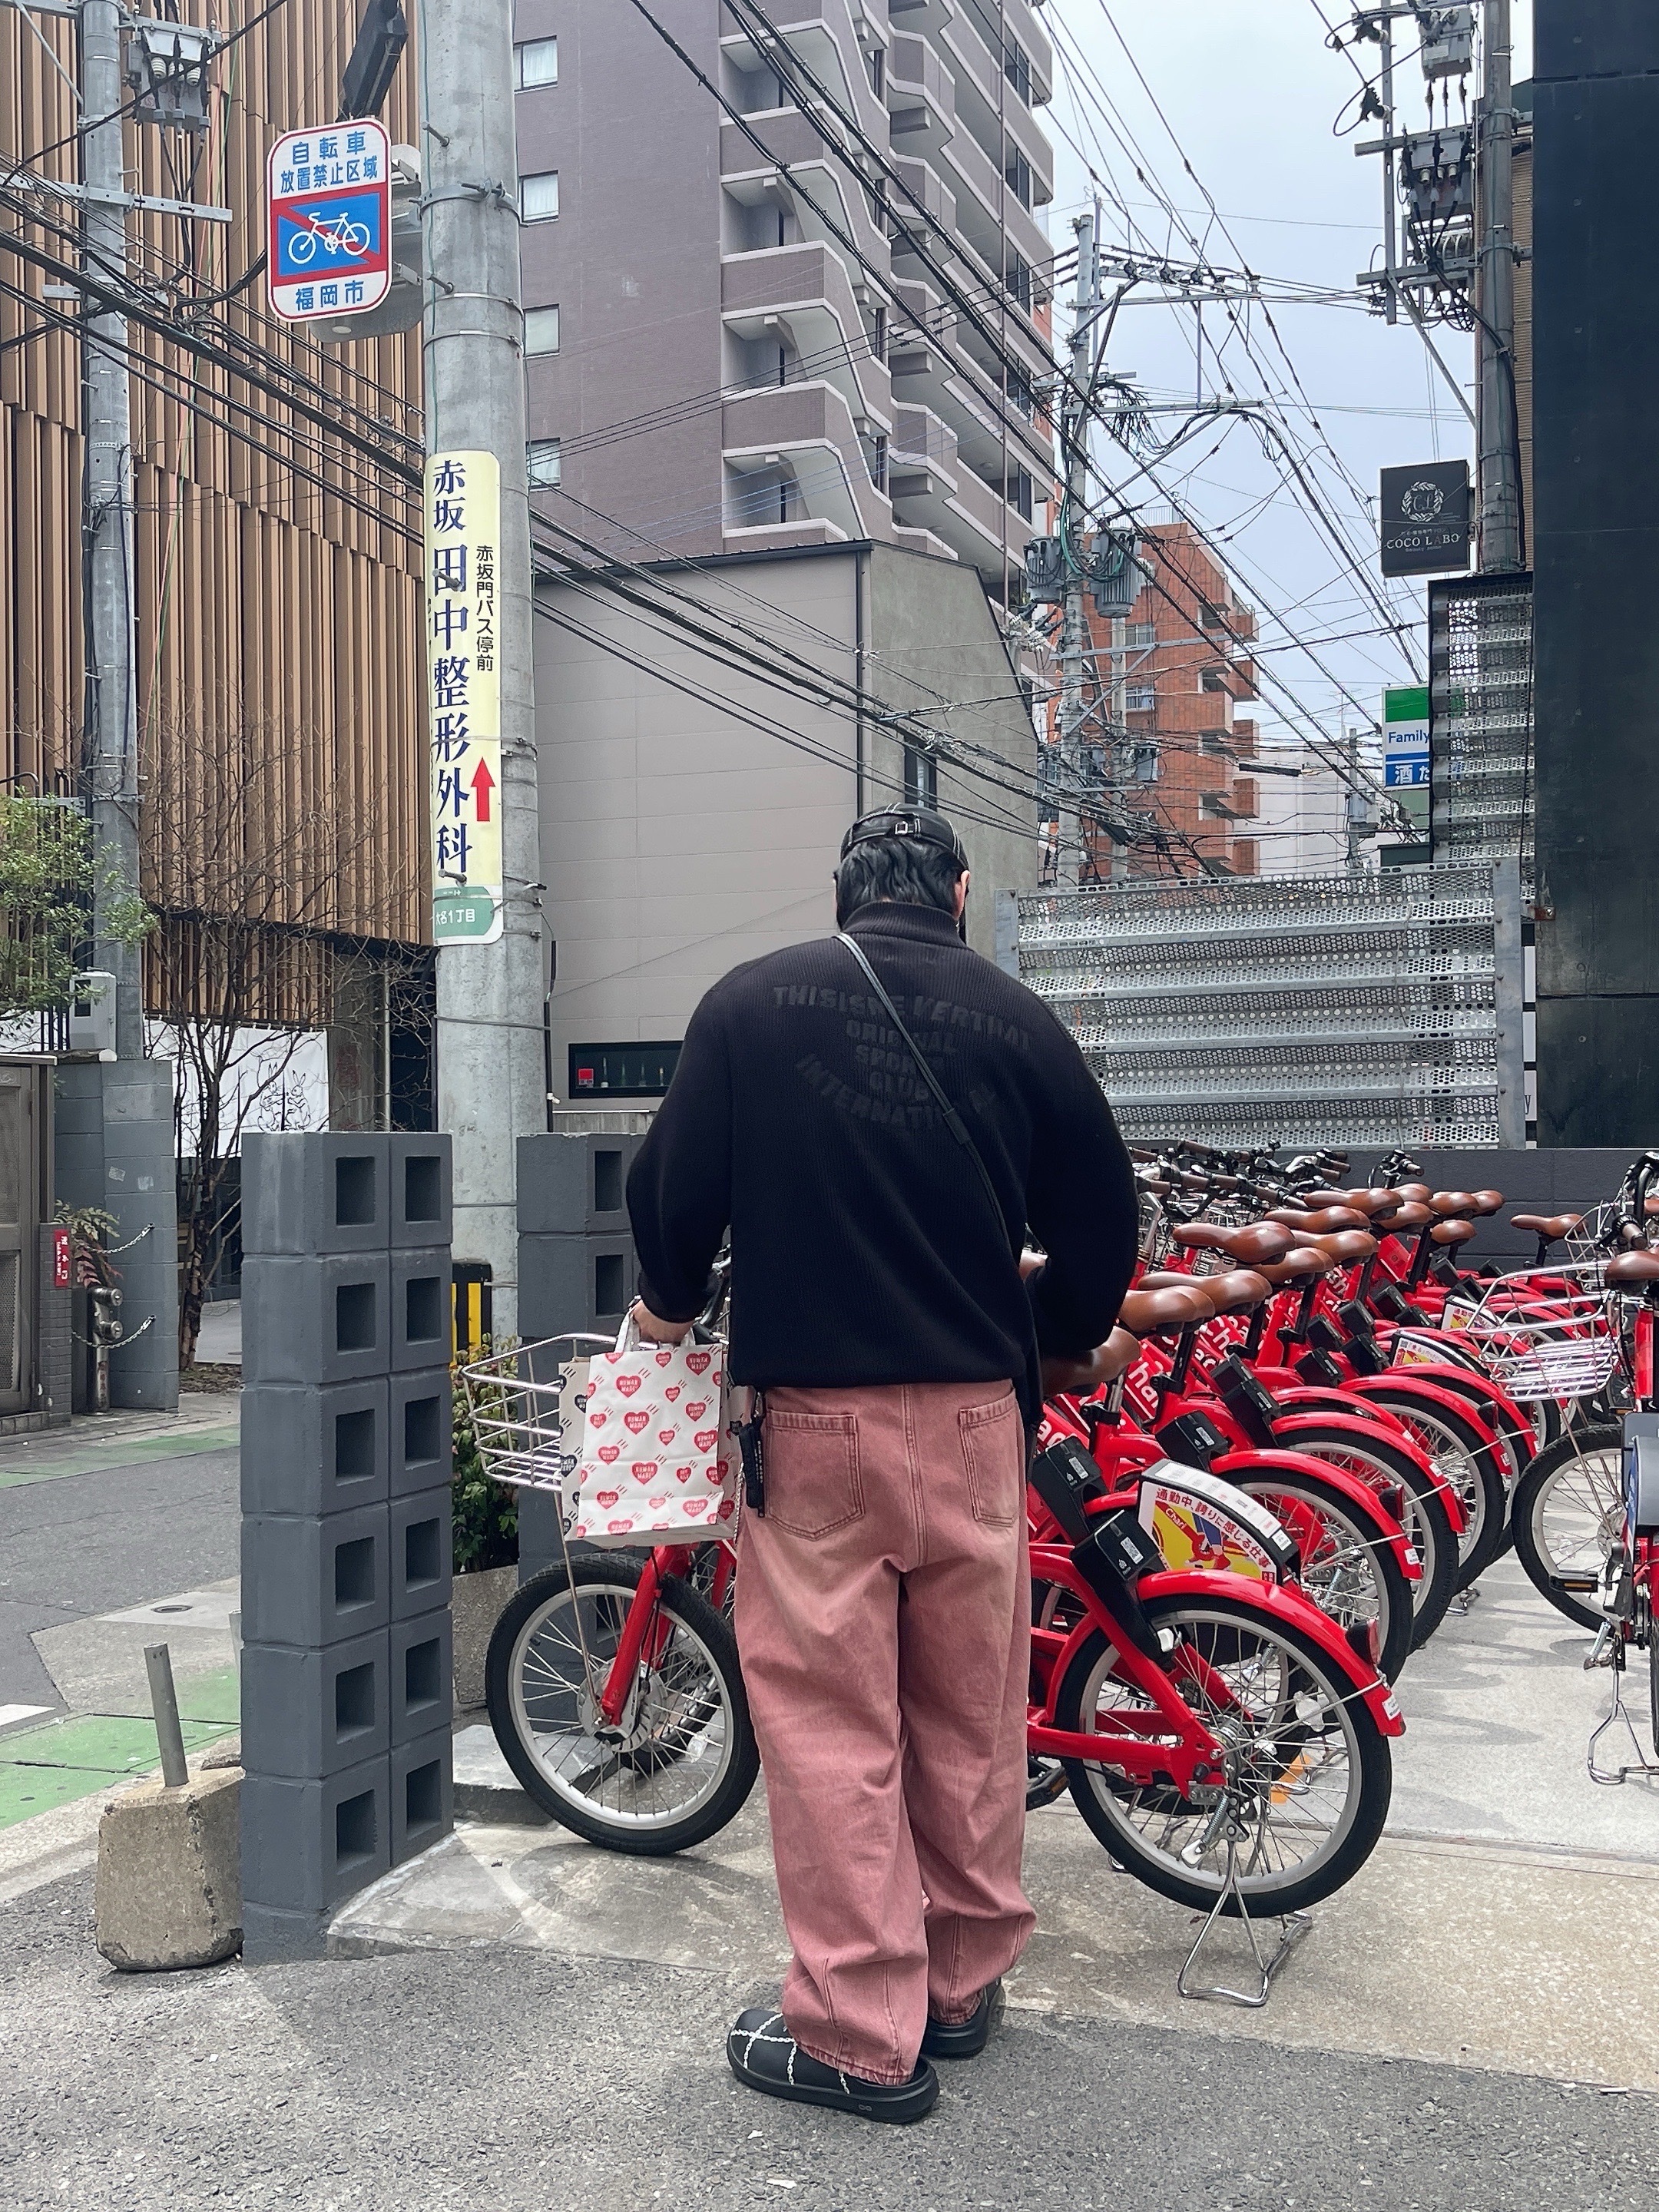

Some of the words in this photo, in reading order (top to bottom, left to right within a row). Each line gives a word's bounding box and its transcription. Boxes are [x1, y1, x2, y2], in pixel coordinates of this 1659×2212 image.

[293, 131, 366, 164] 自転車
[280, 156, 378, 193] 放置禁止区域
[296, 280, 363, 310] 福岡市
[1386, 537, 1420, 549] COCO
[1426, 533, 1459, 545] LABO
[476, 545, 494, 671] 赤坂門バス停前
[846, 1019, 958, 1055] ORIGNAL
